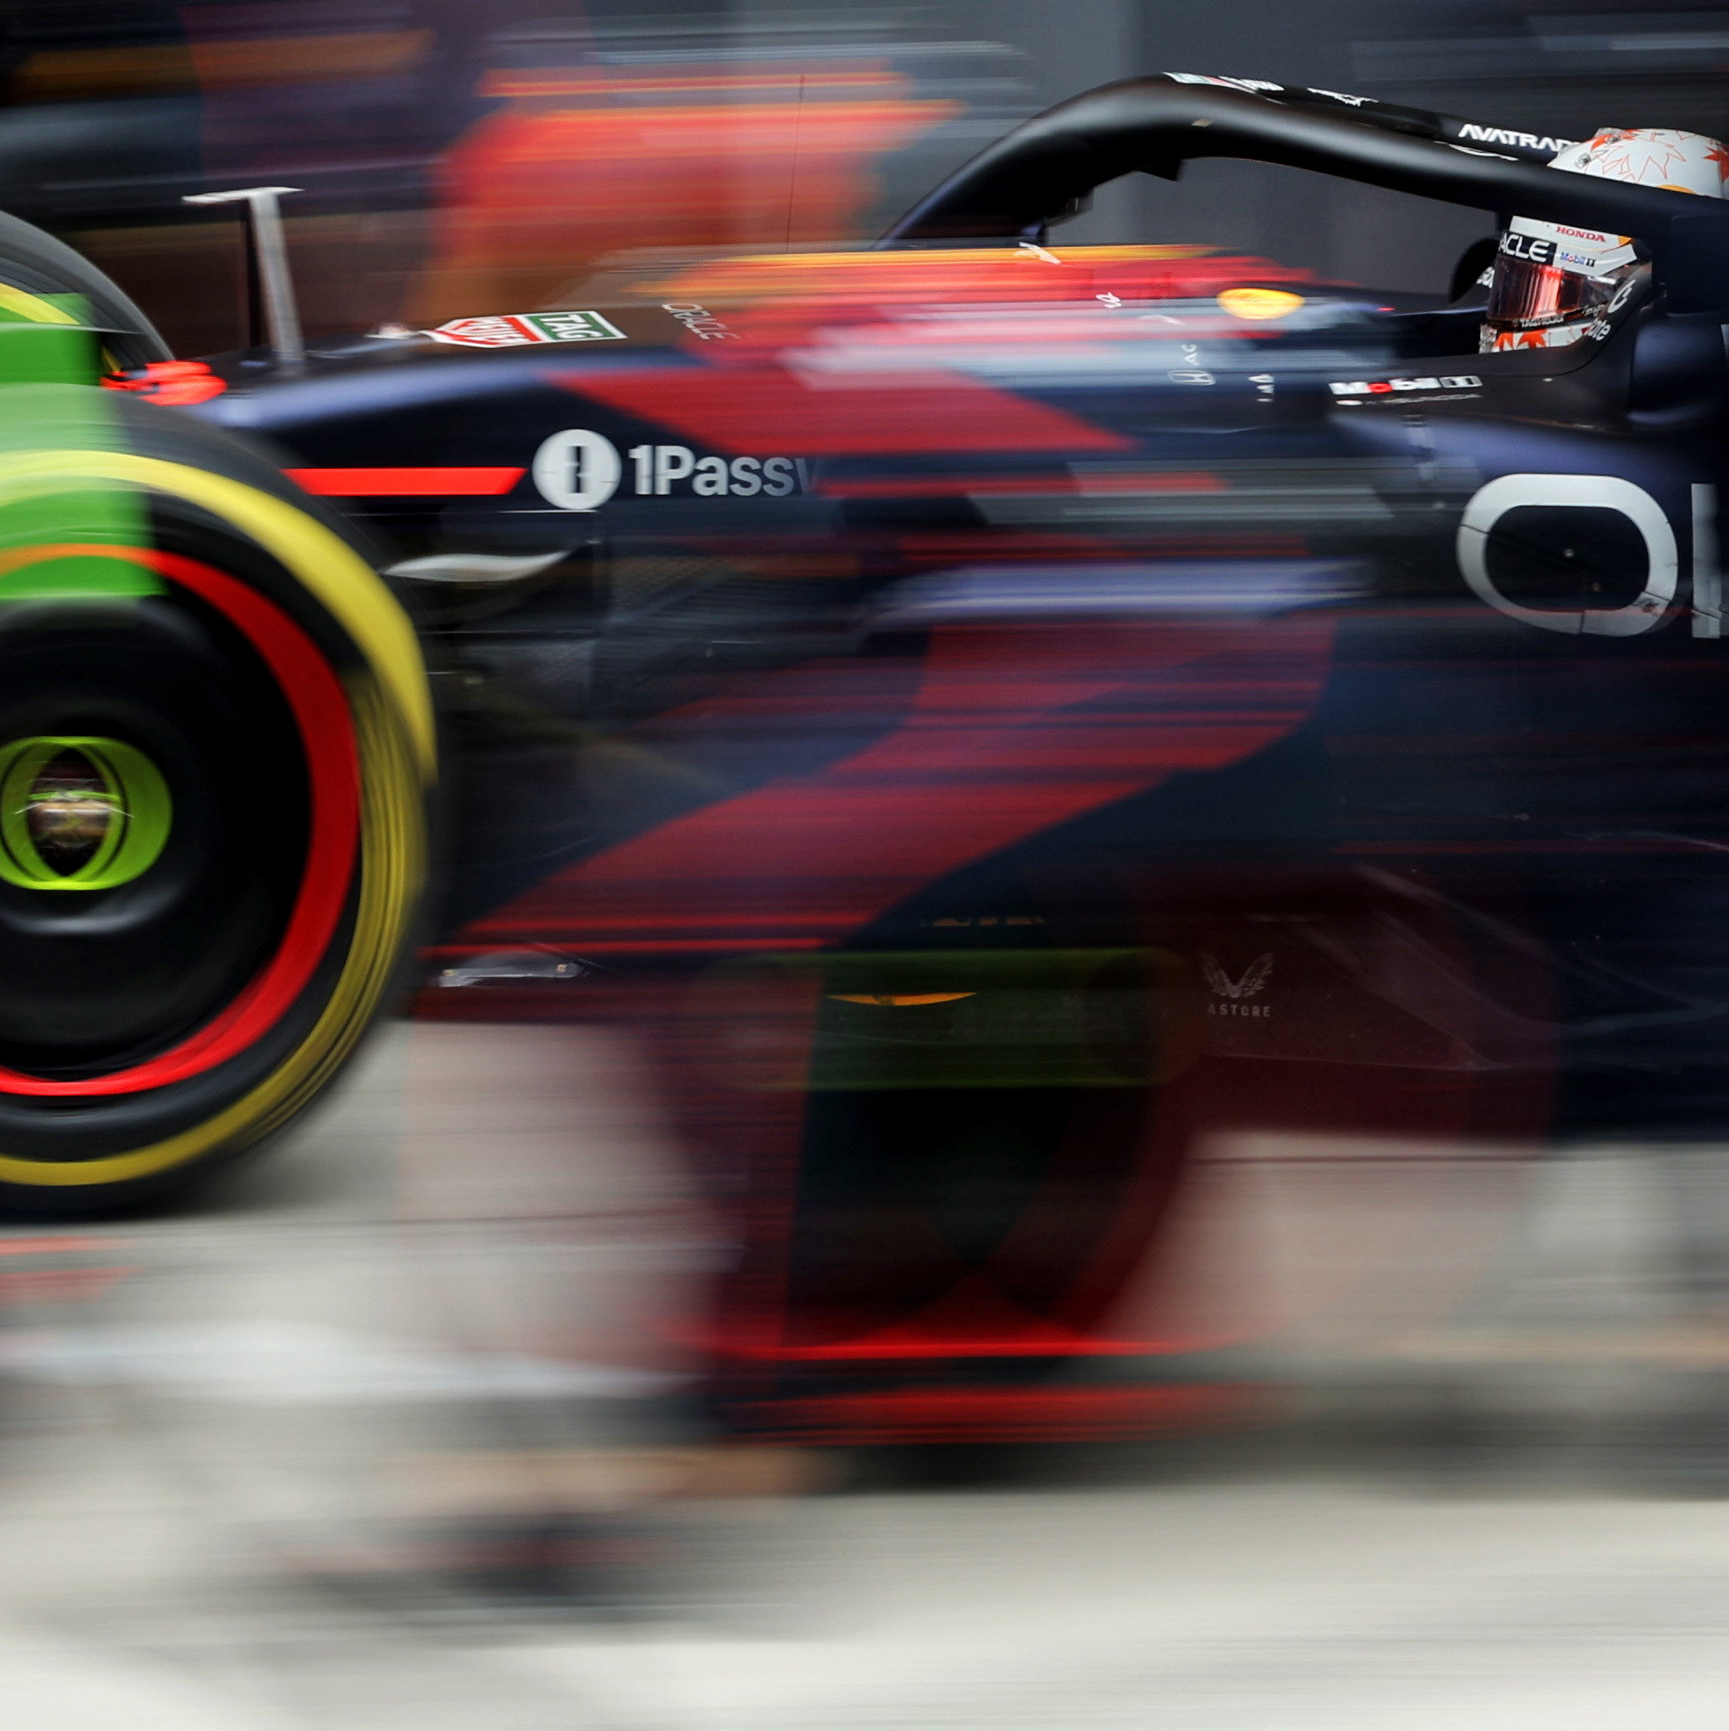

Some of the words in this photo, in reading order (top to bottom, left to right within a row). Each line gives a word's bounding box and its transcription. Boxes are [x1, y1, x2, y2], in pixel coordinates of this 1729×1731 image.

[1458, 123, 1580, 151] AVATRAD
[1556, 226, 1607, 242] HONDA
[1498, 232, 1550, 263] ACLE
[538, 313, 604, 339] TAG
[1208, 1003, 1272, 1018] ASTORE
